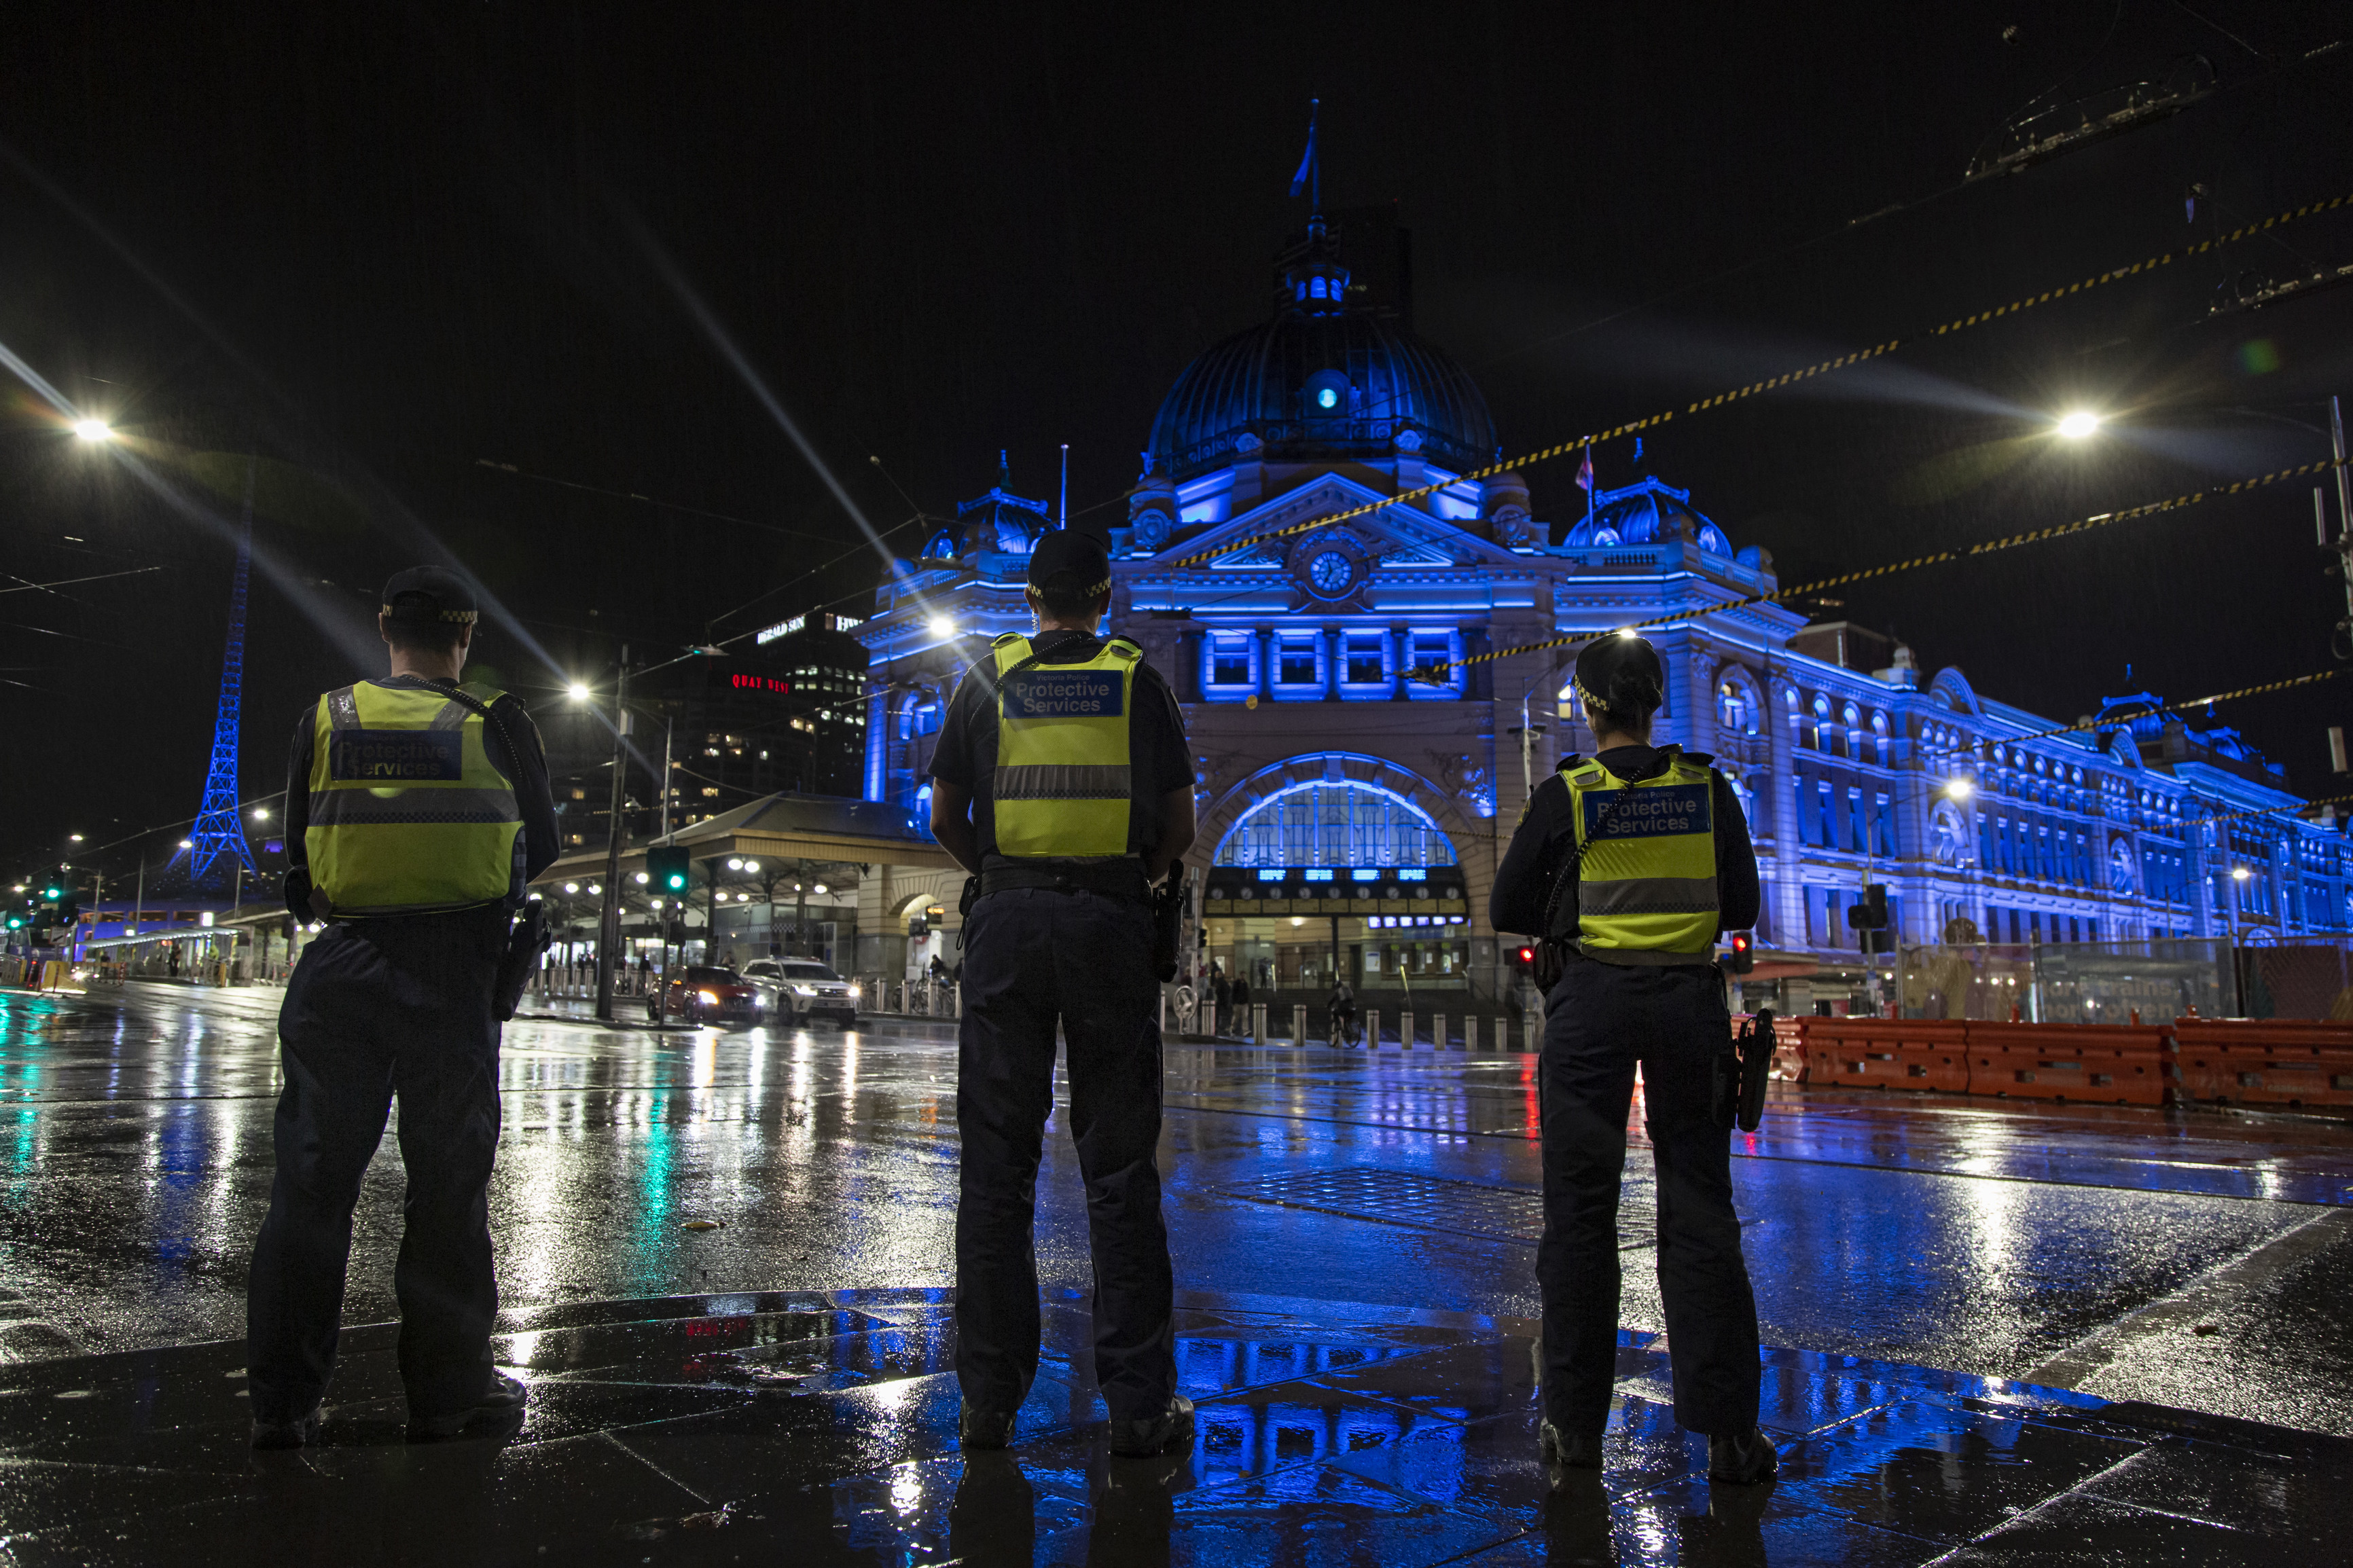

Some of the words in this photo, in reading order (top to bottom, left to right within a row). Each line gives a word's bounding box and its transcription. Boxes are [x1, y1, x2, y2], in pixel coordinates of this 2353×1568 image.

[788, 616, 805, 632] SUN
[836, 615, 864, 632] HW
[732, 674, 761, 688] QUAY
[768, 679, 789, 694] WEST
[1016, 681, 1110, 698] Protective
[1024, 697, 1101, 713] Services
[340, 742, 449, 759] Protective
[347, 759, 441, 776] Services
[1650, 790, 1675, 799] Police
[1606, 816, 1689, 835] Services
